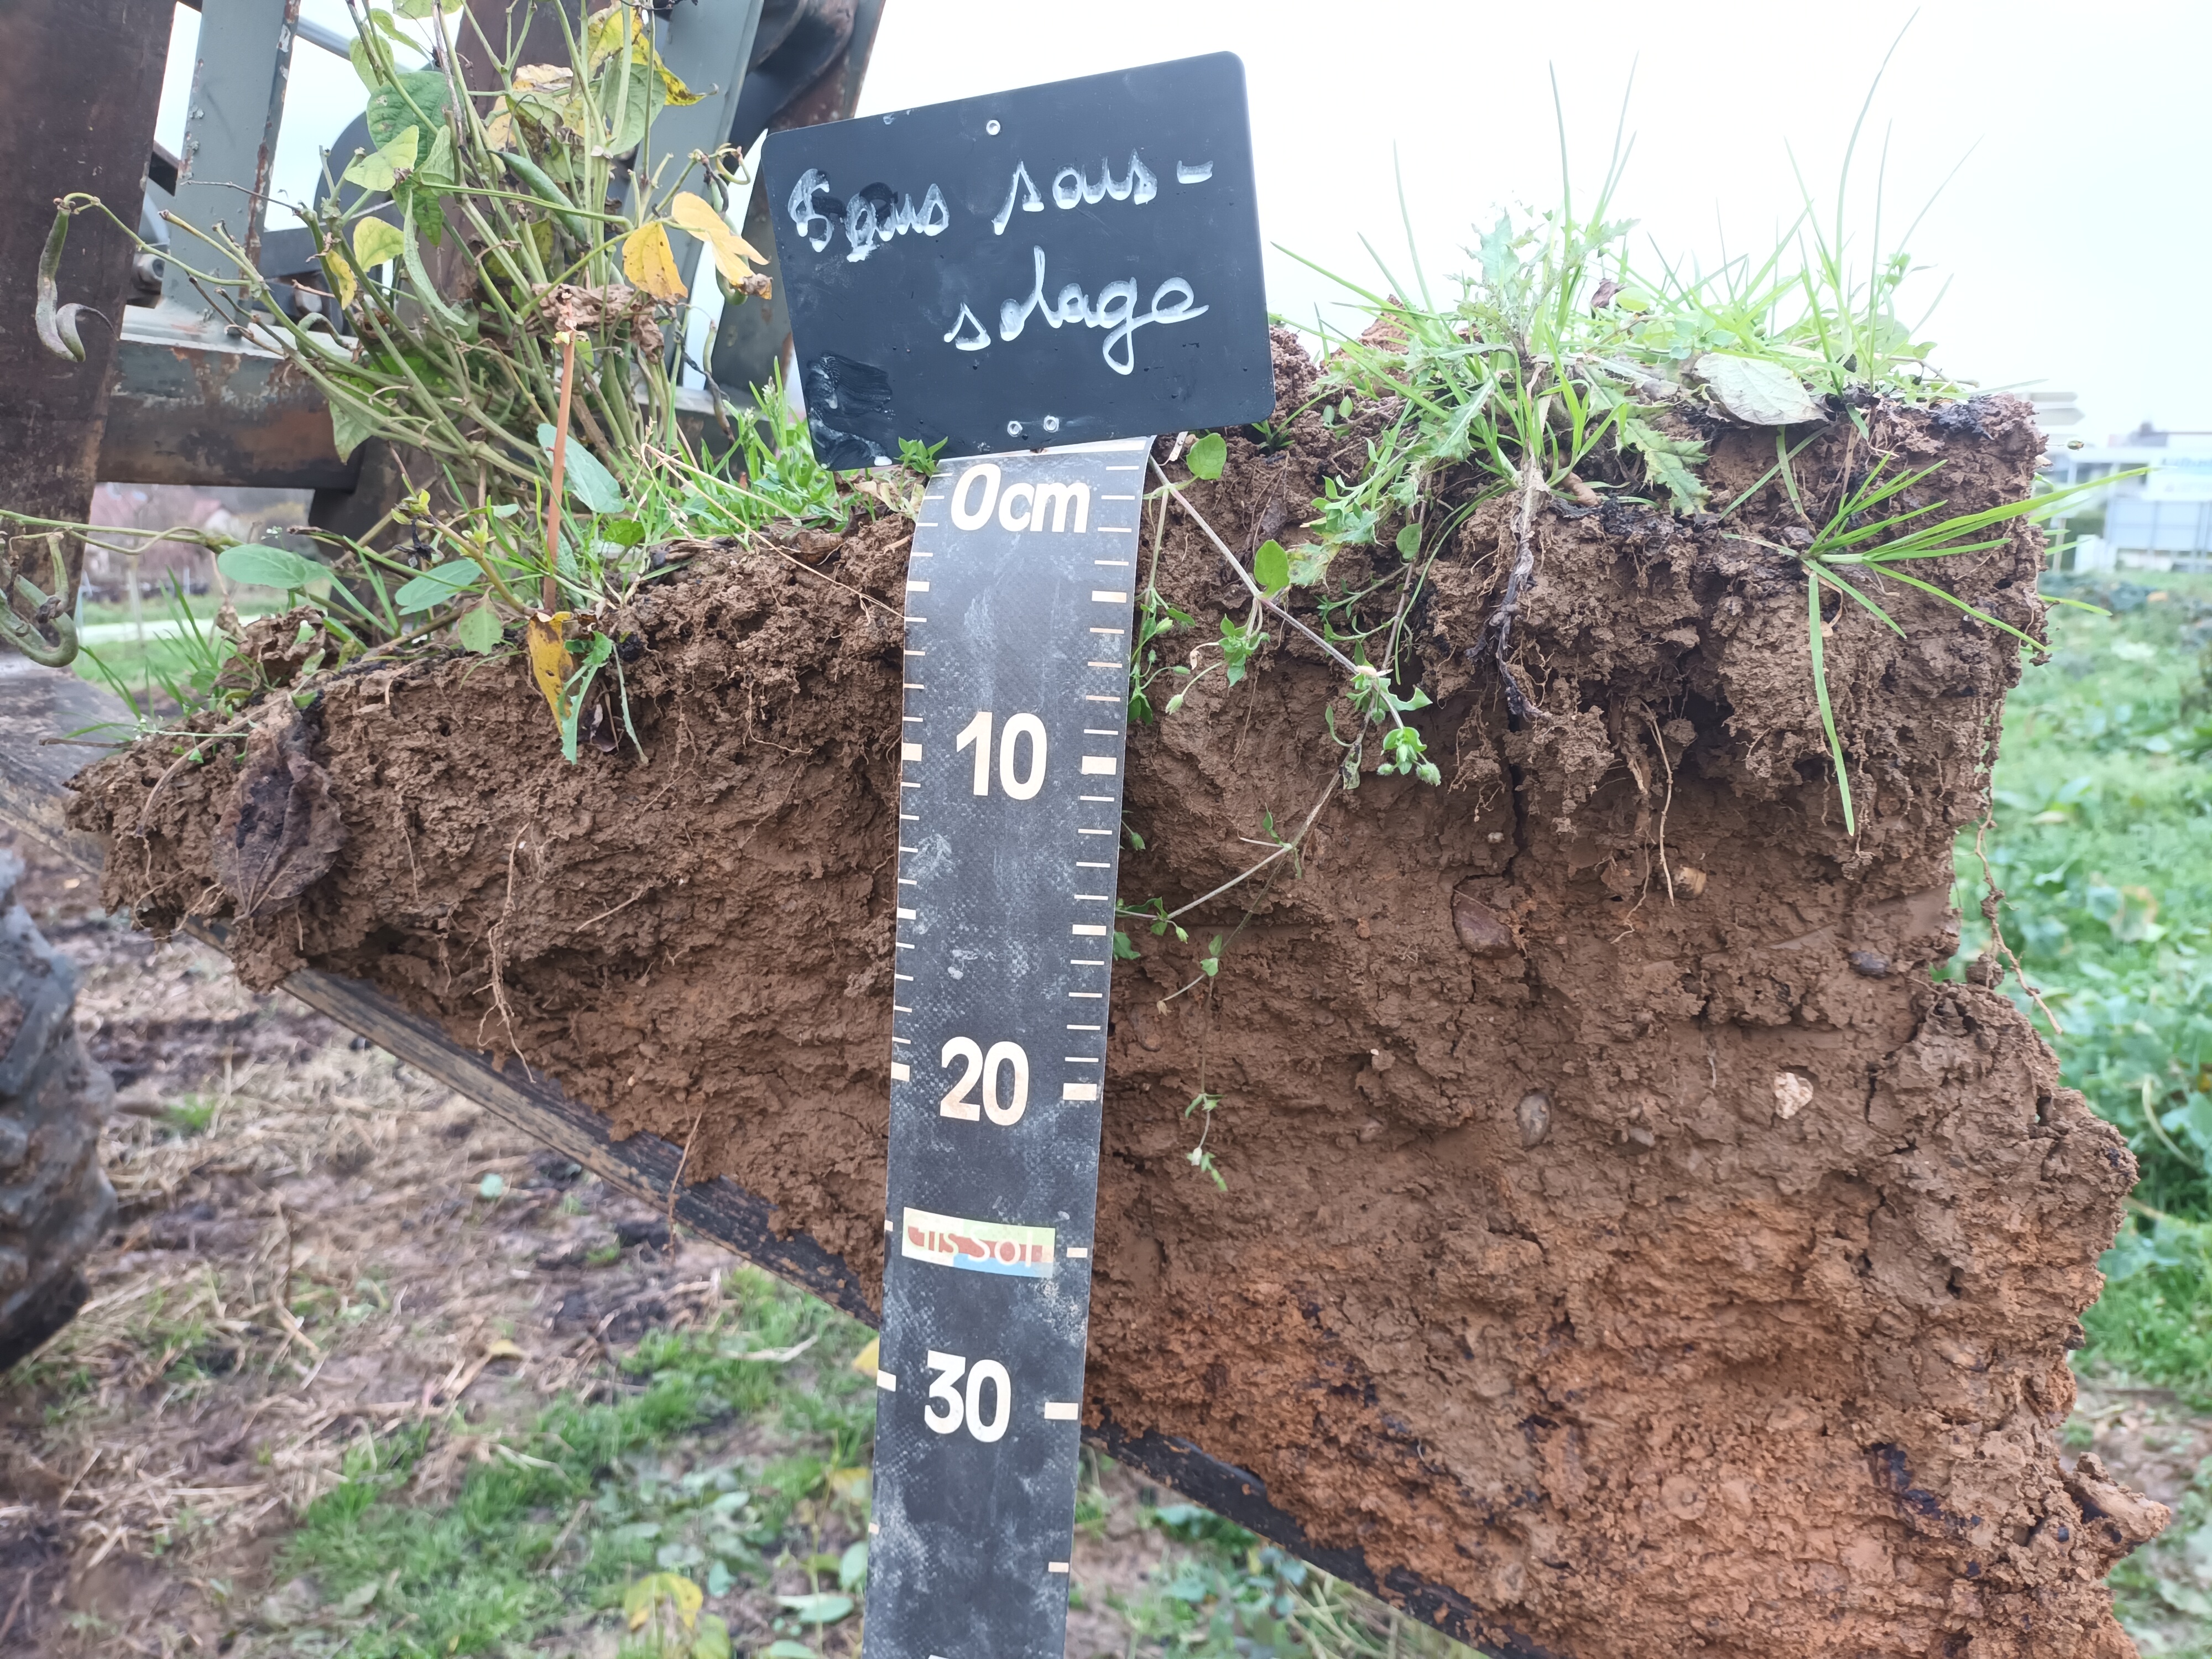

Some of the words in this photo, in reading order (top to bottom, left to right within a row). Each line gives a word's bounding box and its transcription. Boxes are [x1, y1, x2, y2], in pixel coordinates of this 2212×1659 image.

[943, 245, 1209, 375] solage
[956, 711, 1047, 800] 10
[940, 1036, 1029, 1126] 20
[924, 1350, 1011, 1442] 30
